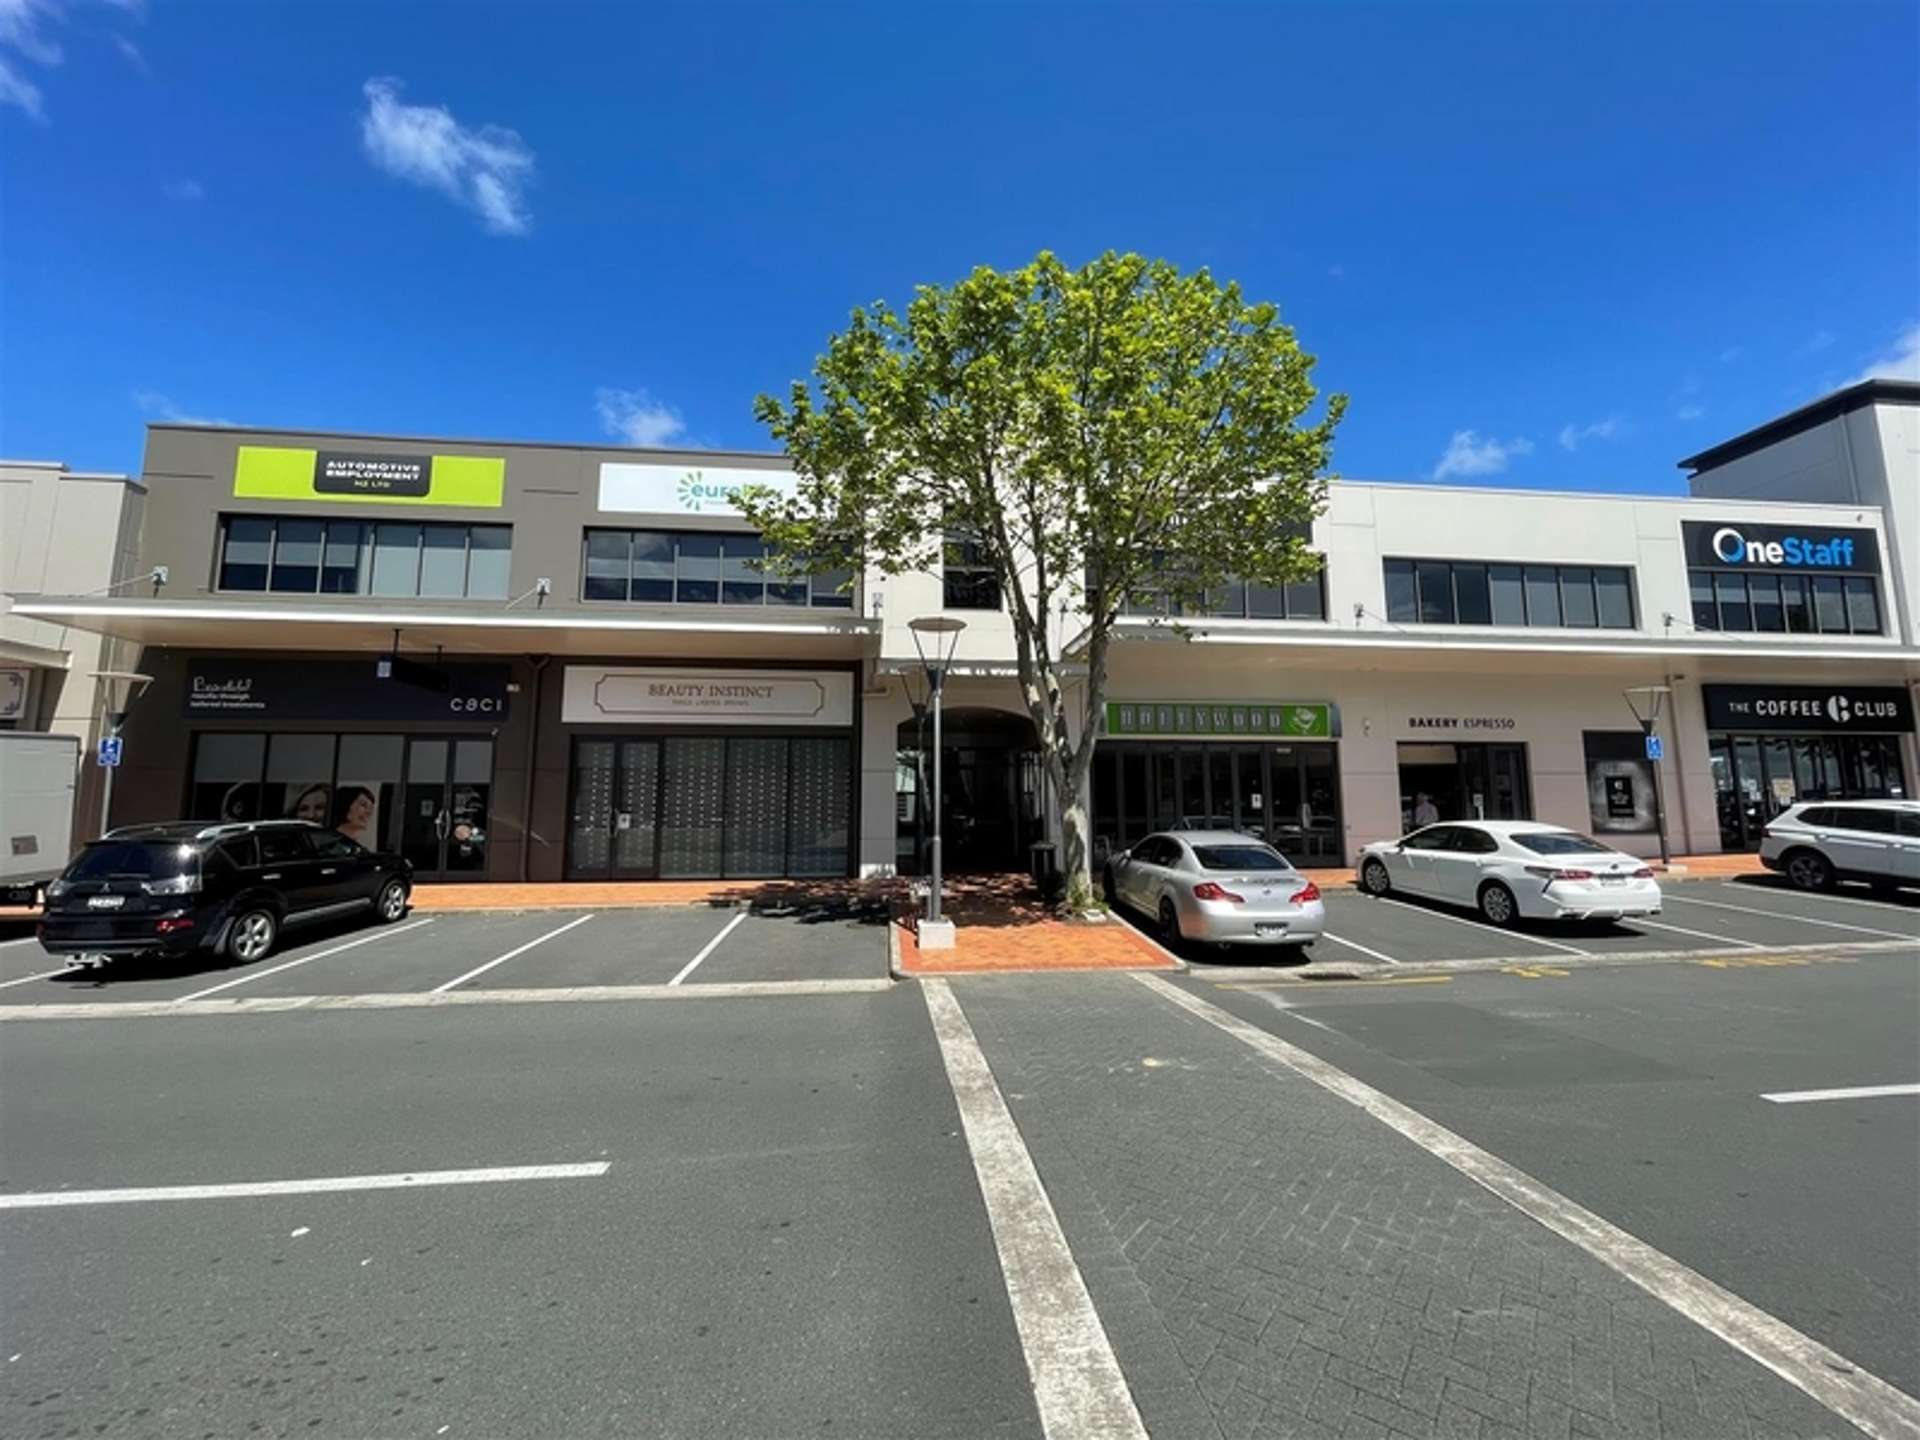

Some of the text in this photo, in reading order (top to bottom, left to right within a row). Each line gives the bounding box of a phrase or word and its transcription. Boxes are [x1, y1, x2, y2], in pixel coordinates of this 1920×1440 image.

[327, 461, 420, 471] AUTOMOTIVE
[326, 470, 420, 480] EMPLOYMENT
[1713, 528, 1854, 566] OneStaff
[648, 684, 774, 699] BEAUTY INSTINCT
[1729, 702, 1750, 713] THE
[1756, 700, 1822, 716] COFFEE
[1855, 701, 1898, 717] CLUB
[1121, 709, 1281, 727] HOLLYWOOD
[1408, 717, 1516, 729] BAKERY ESPRESSO
